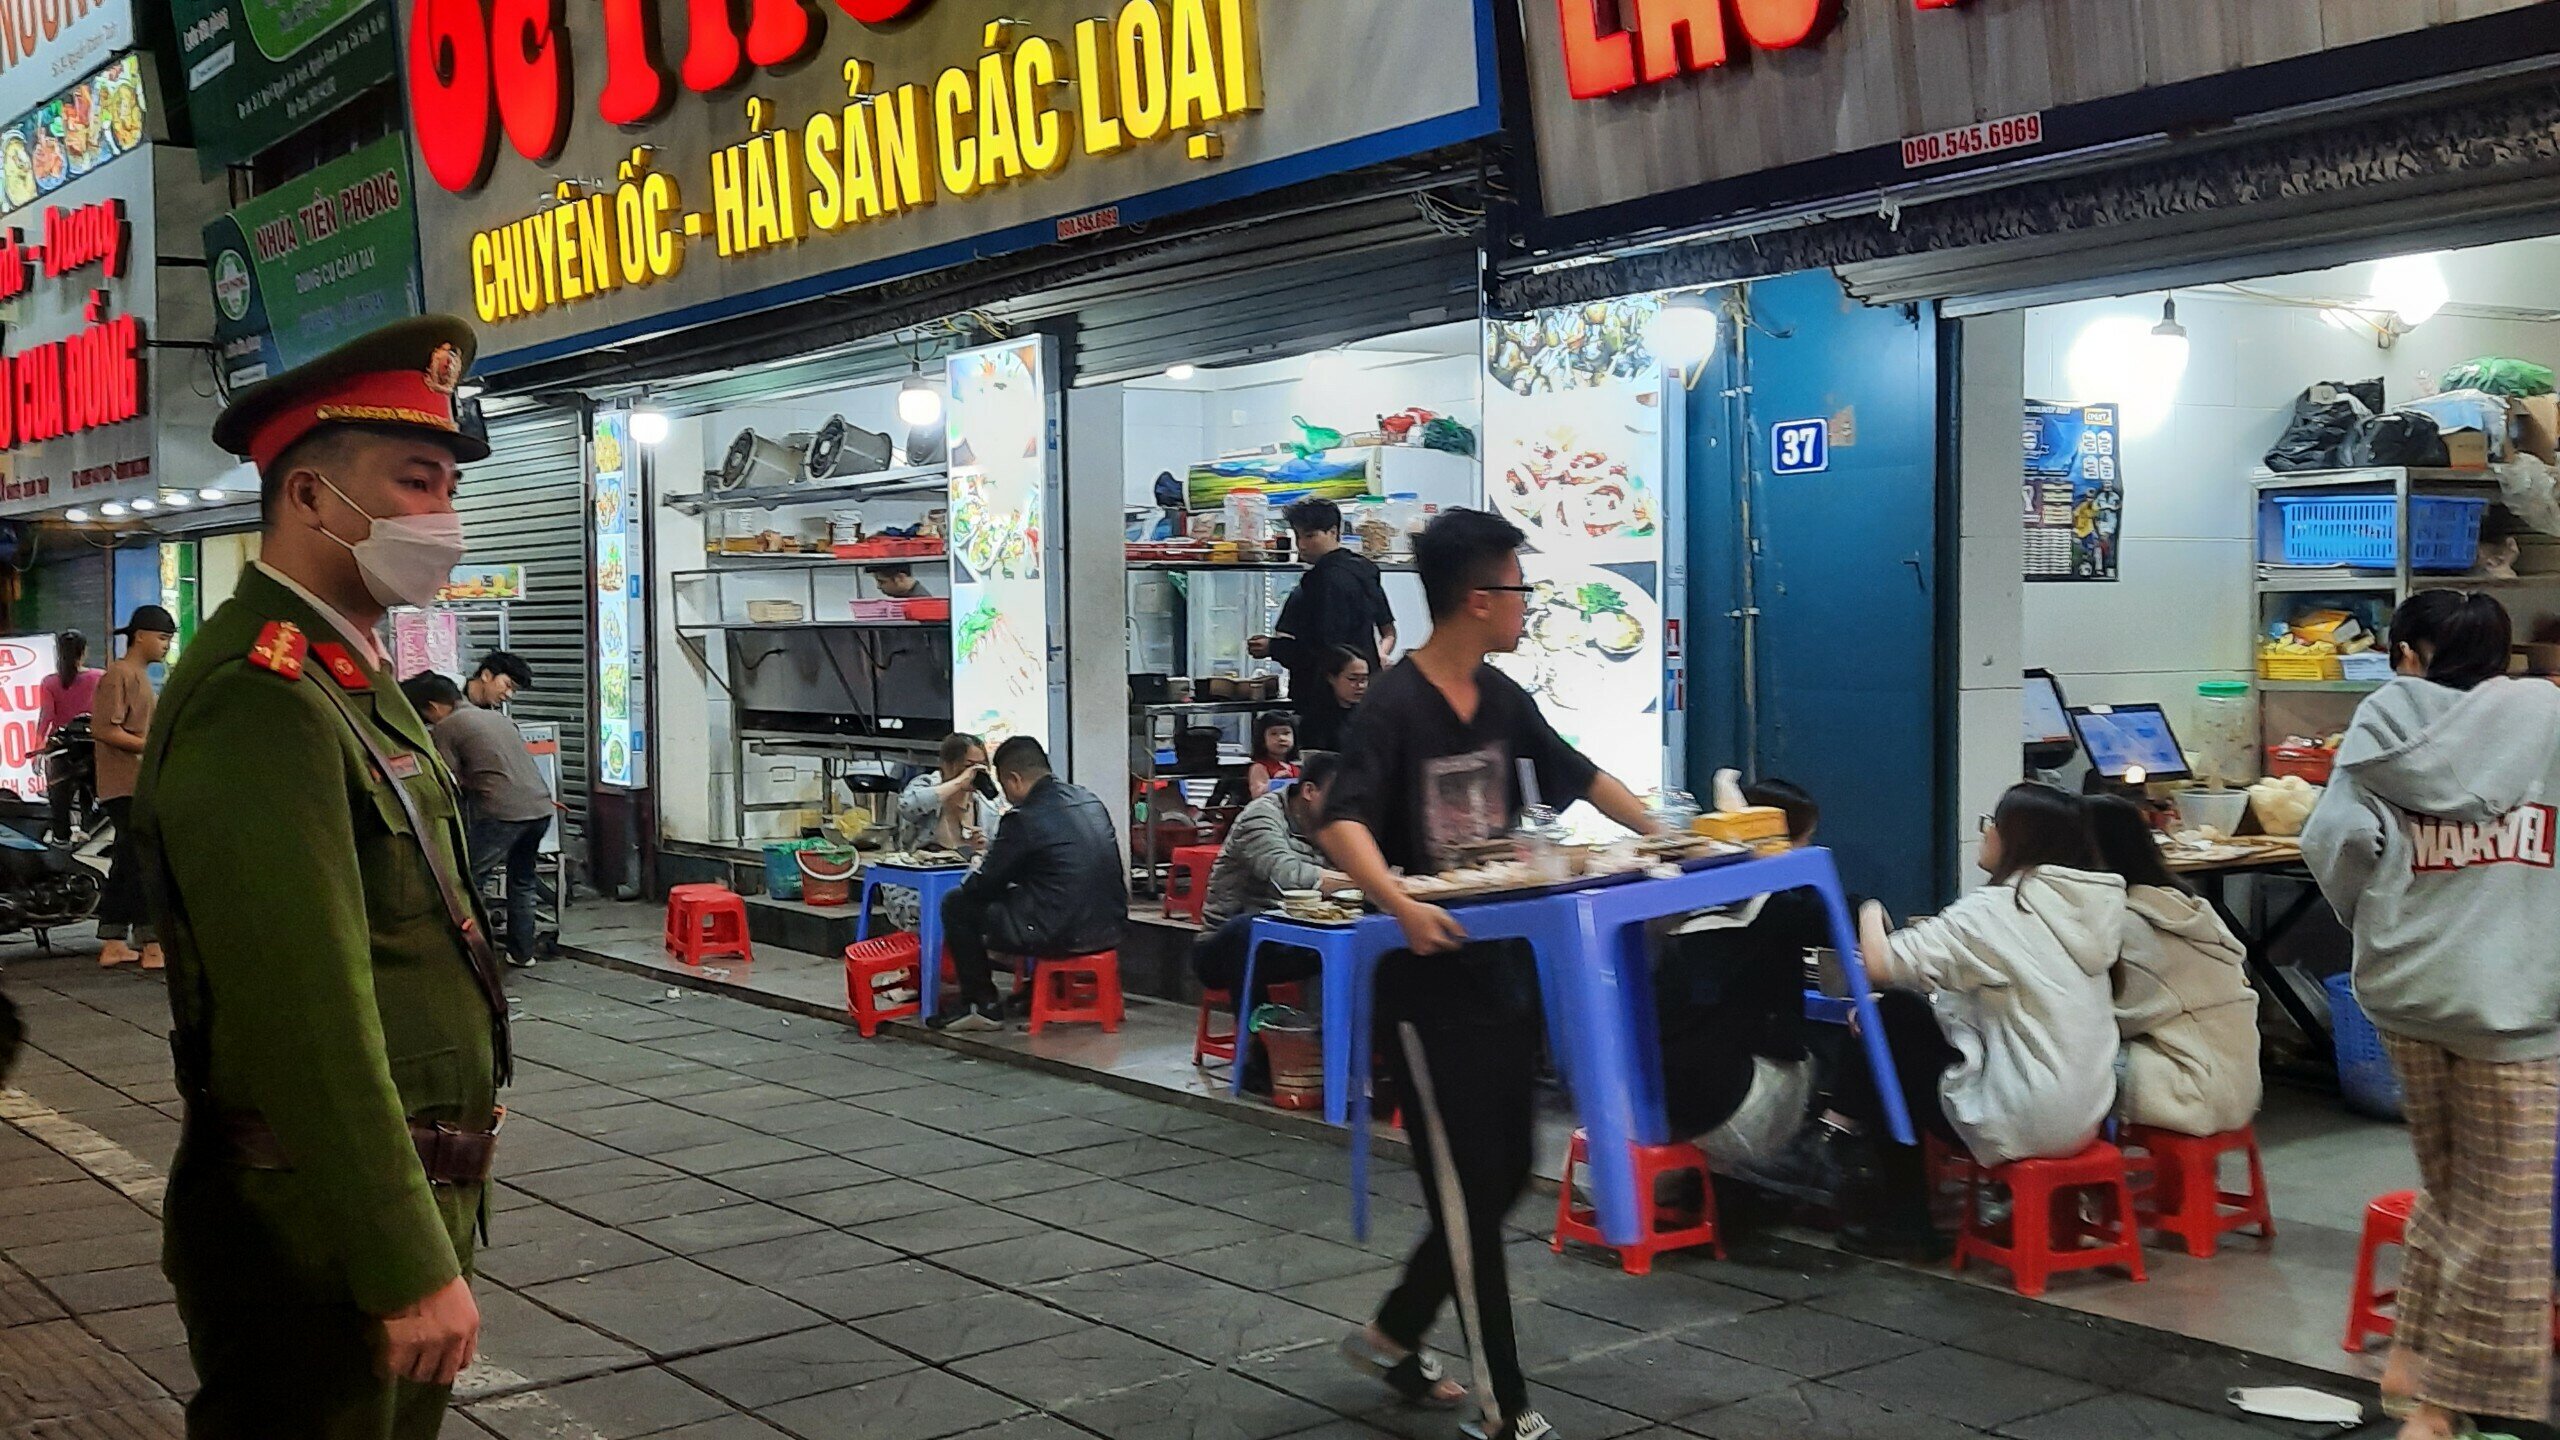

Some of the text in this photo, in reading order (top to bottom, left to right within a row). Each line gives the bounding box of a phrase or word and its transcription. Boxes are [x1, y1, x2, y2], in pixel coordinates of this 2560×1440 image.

[471, 181, 611, 323] CHUYÊN
[616, 146, 673, 284] ỐC
[711, 97, 796, 257] HẢI
[805, 58, 924, 229] SẢN
[935, 20, 1060, 195] CÁC
[1075, 0, 1249, 160] LOẠI
[1905, 115, 2039, 165] 090.545.6969
[340, 168, 400, 228] PHONG
[1781, 427, 1818, 466] 37
[2411, 805, 2551, 868] MARVEL
